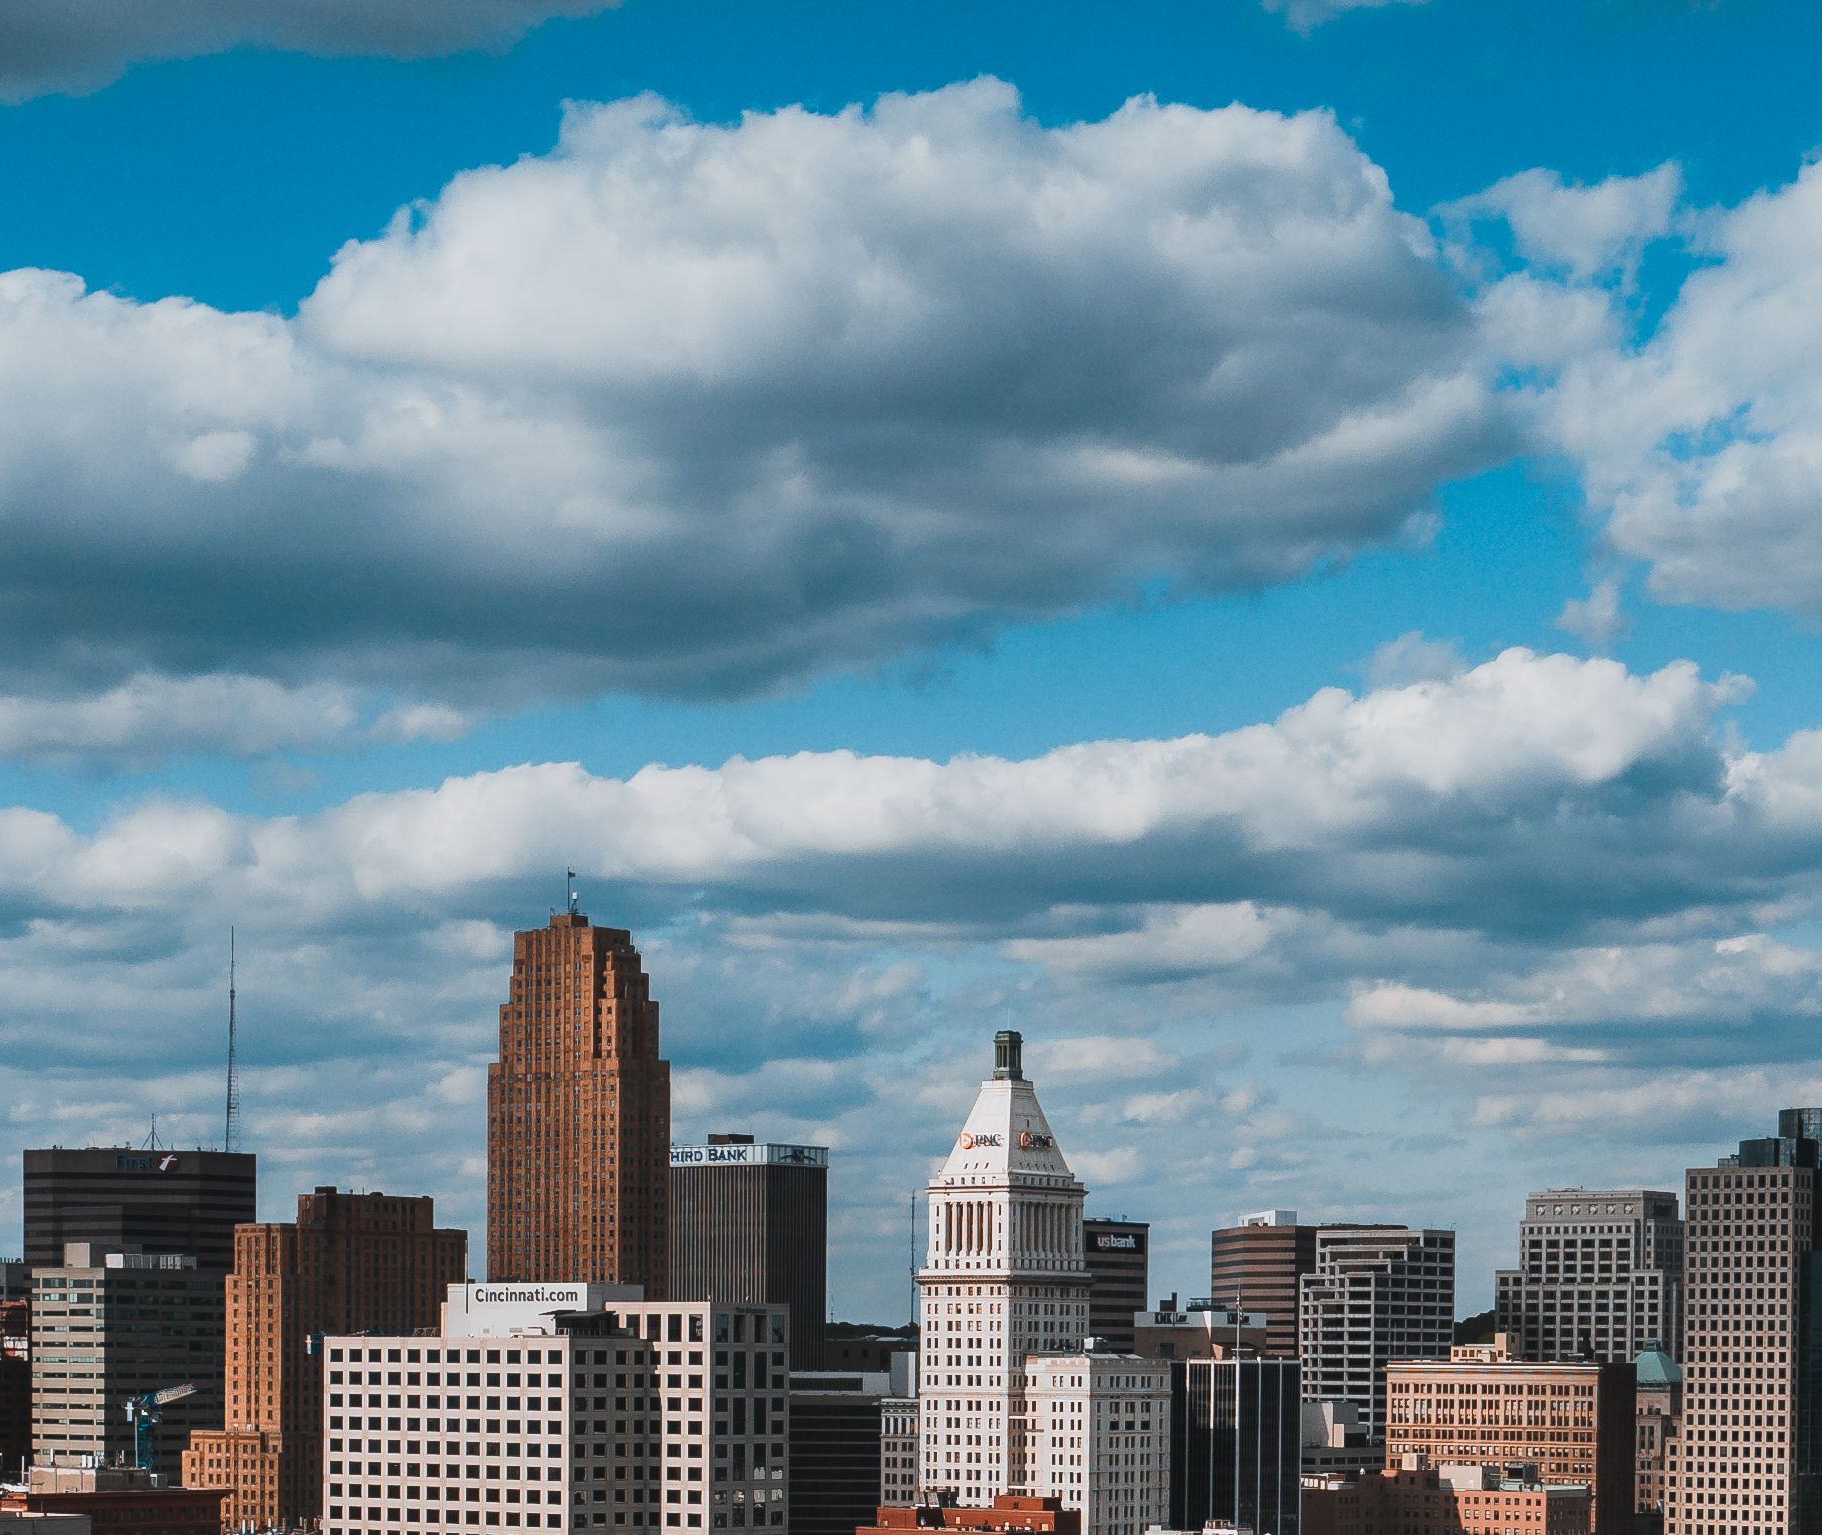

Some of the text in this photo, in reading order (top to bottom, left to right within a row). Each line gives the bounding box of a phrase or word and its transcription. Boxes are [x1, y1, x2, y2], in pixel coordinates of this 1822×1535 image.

[670, 1148, 747, 1163] HIRD BANK
[475, 1286, 578, 1302] Cincinnati.com
